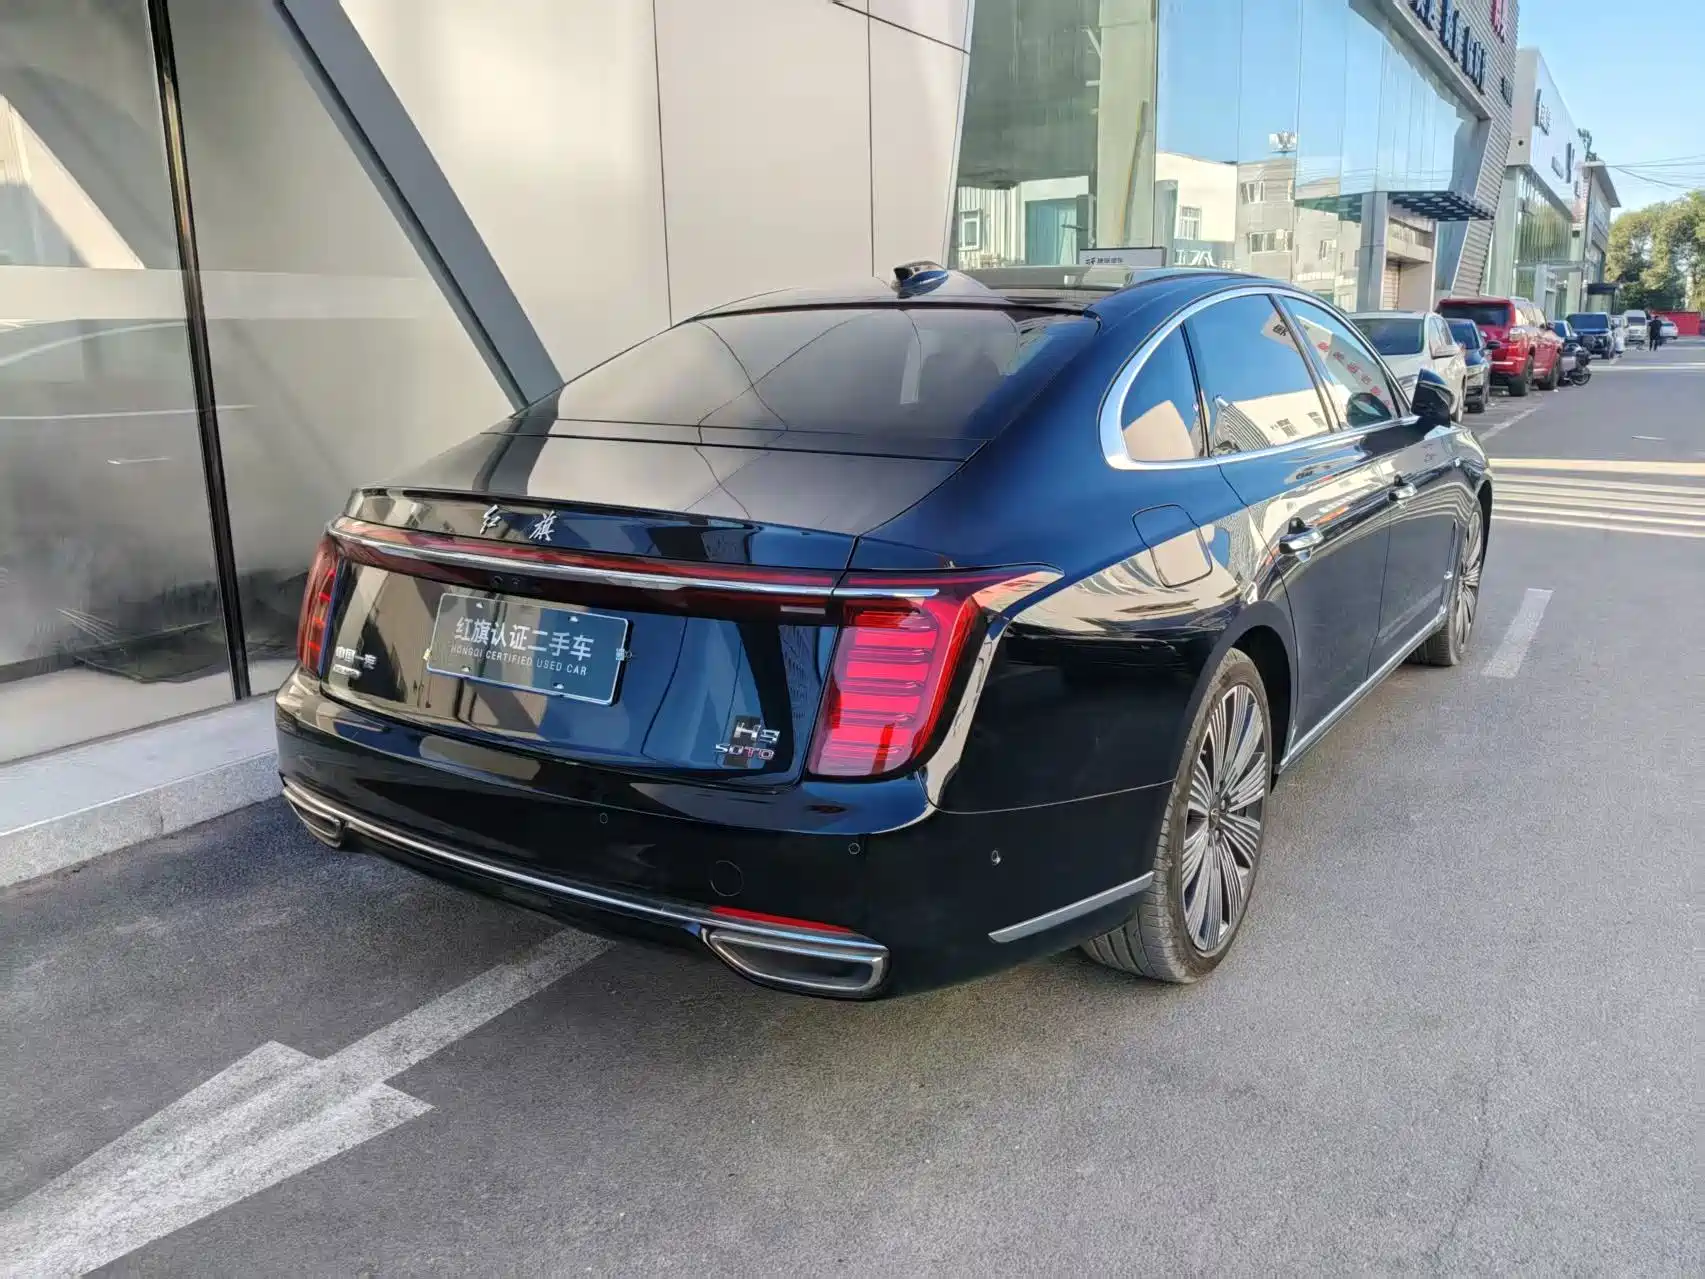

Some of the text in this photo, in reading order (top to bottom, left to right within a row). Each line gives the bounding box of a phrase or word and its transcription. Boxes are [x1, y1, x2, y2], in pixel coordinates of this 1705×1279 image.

[454, 616, 595, 661] 红旗认证二手车
[450, 645, 588, 677] HONGQI CERTIFIED USED CAR
